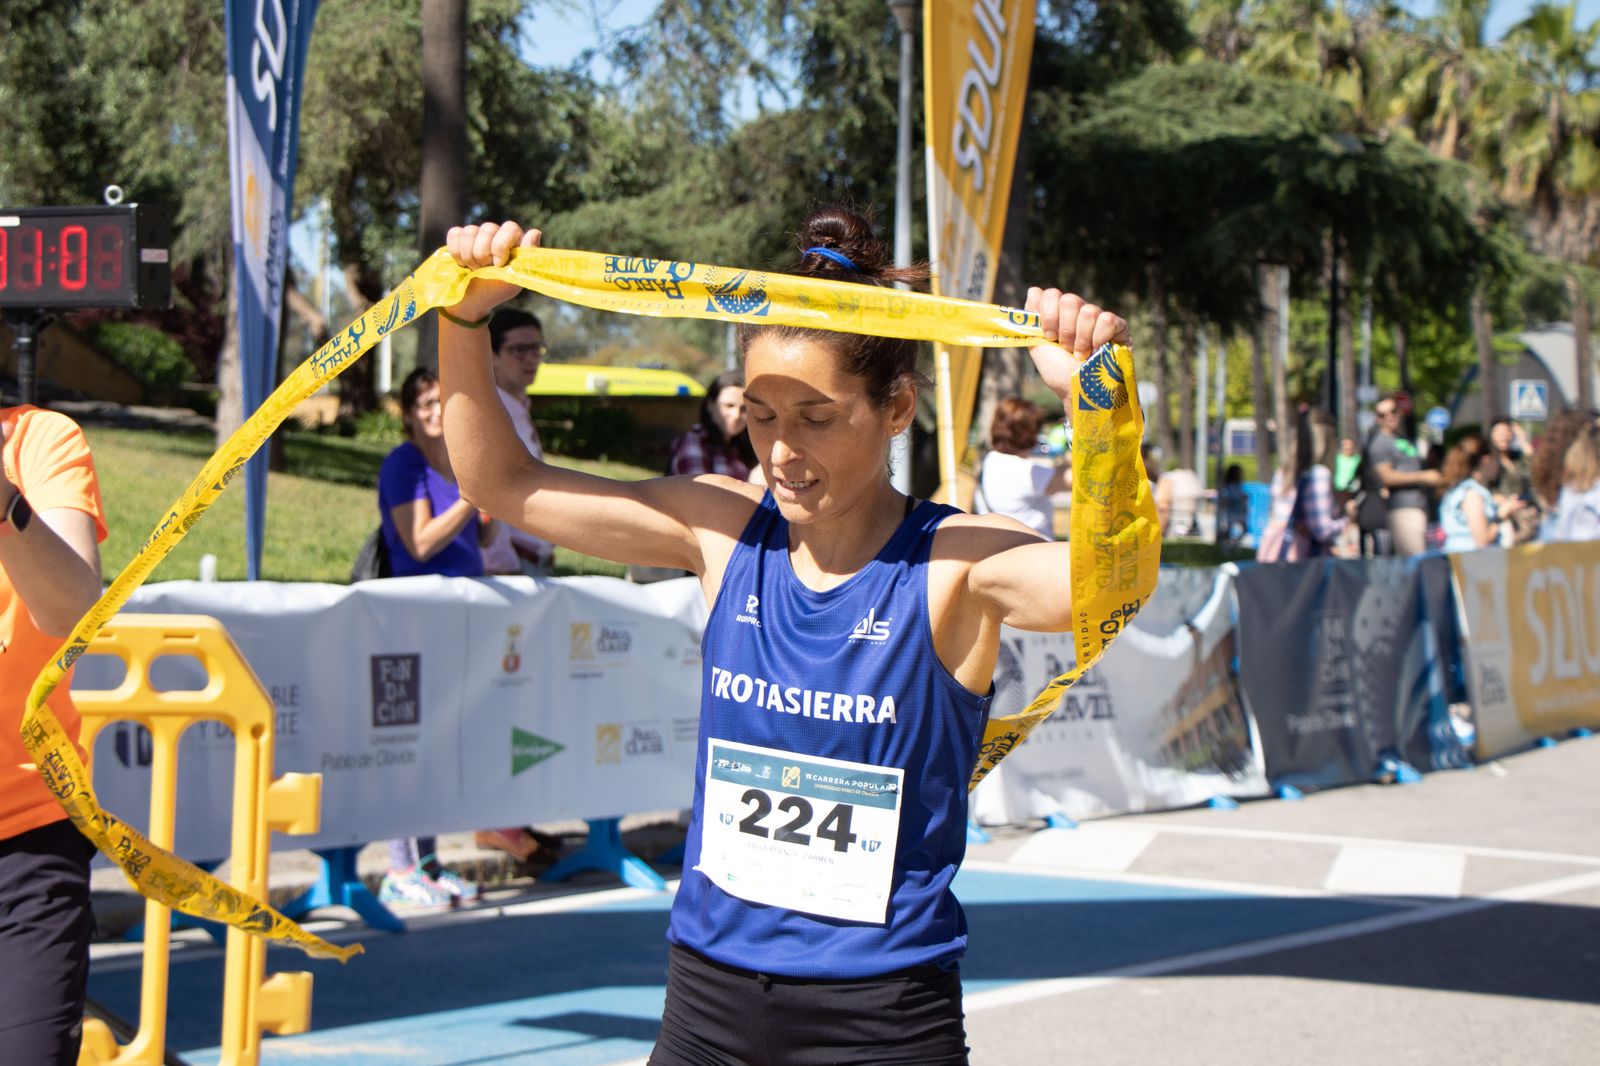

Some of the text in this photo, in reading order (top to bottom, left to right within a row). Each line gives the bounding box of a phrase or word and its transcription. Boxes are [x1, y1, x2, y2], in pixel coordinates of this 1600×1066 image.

[1080, 611, 1091, 665] ERSIDAD
[711, 666, 897, 724] TROTASIERRA
[738, 788, 858, 853] 224
